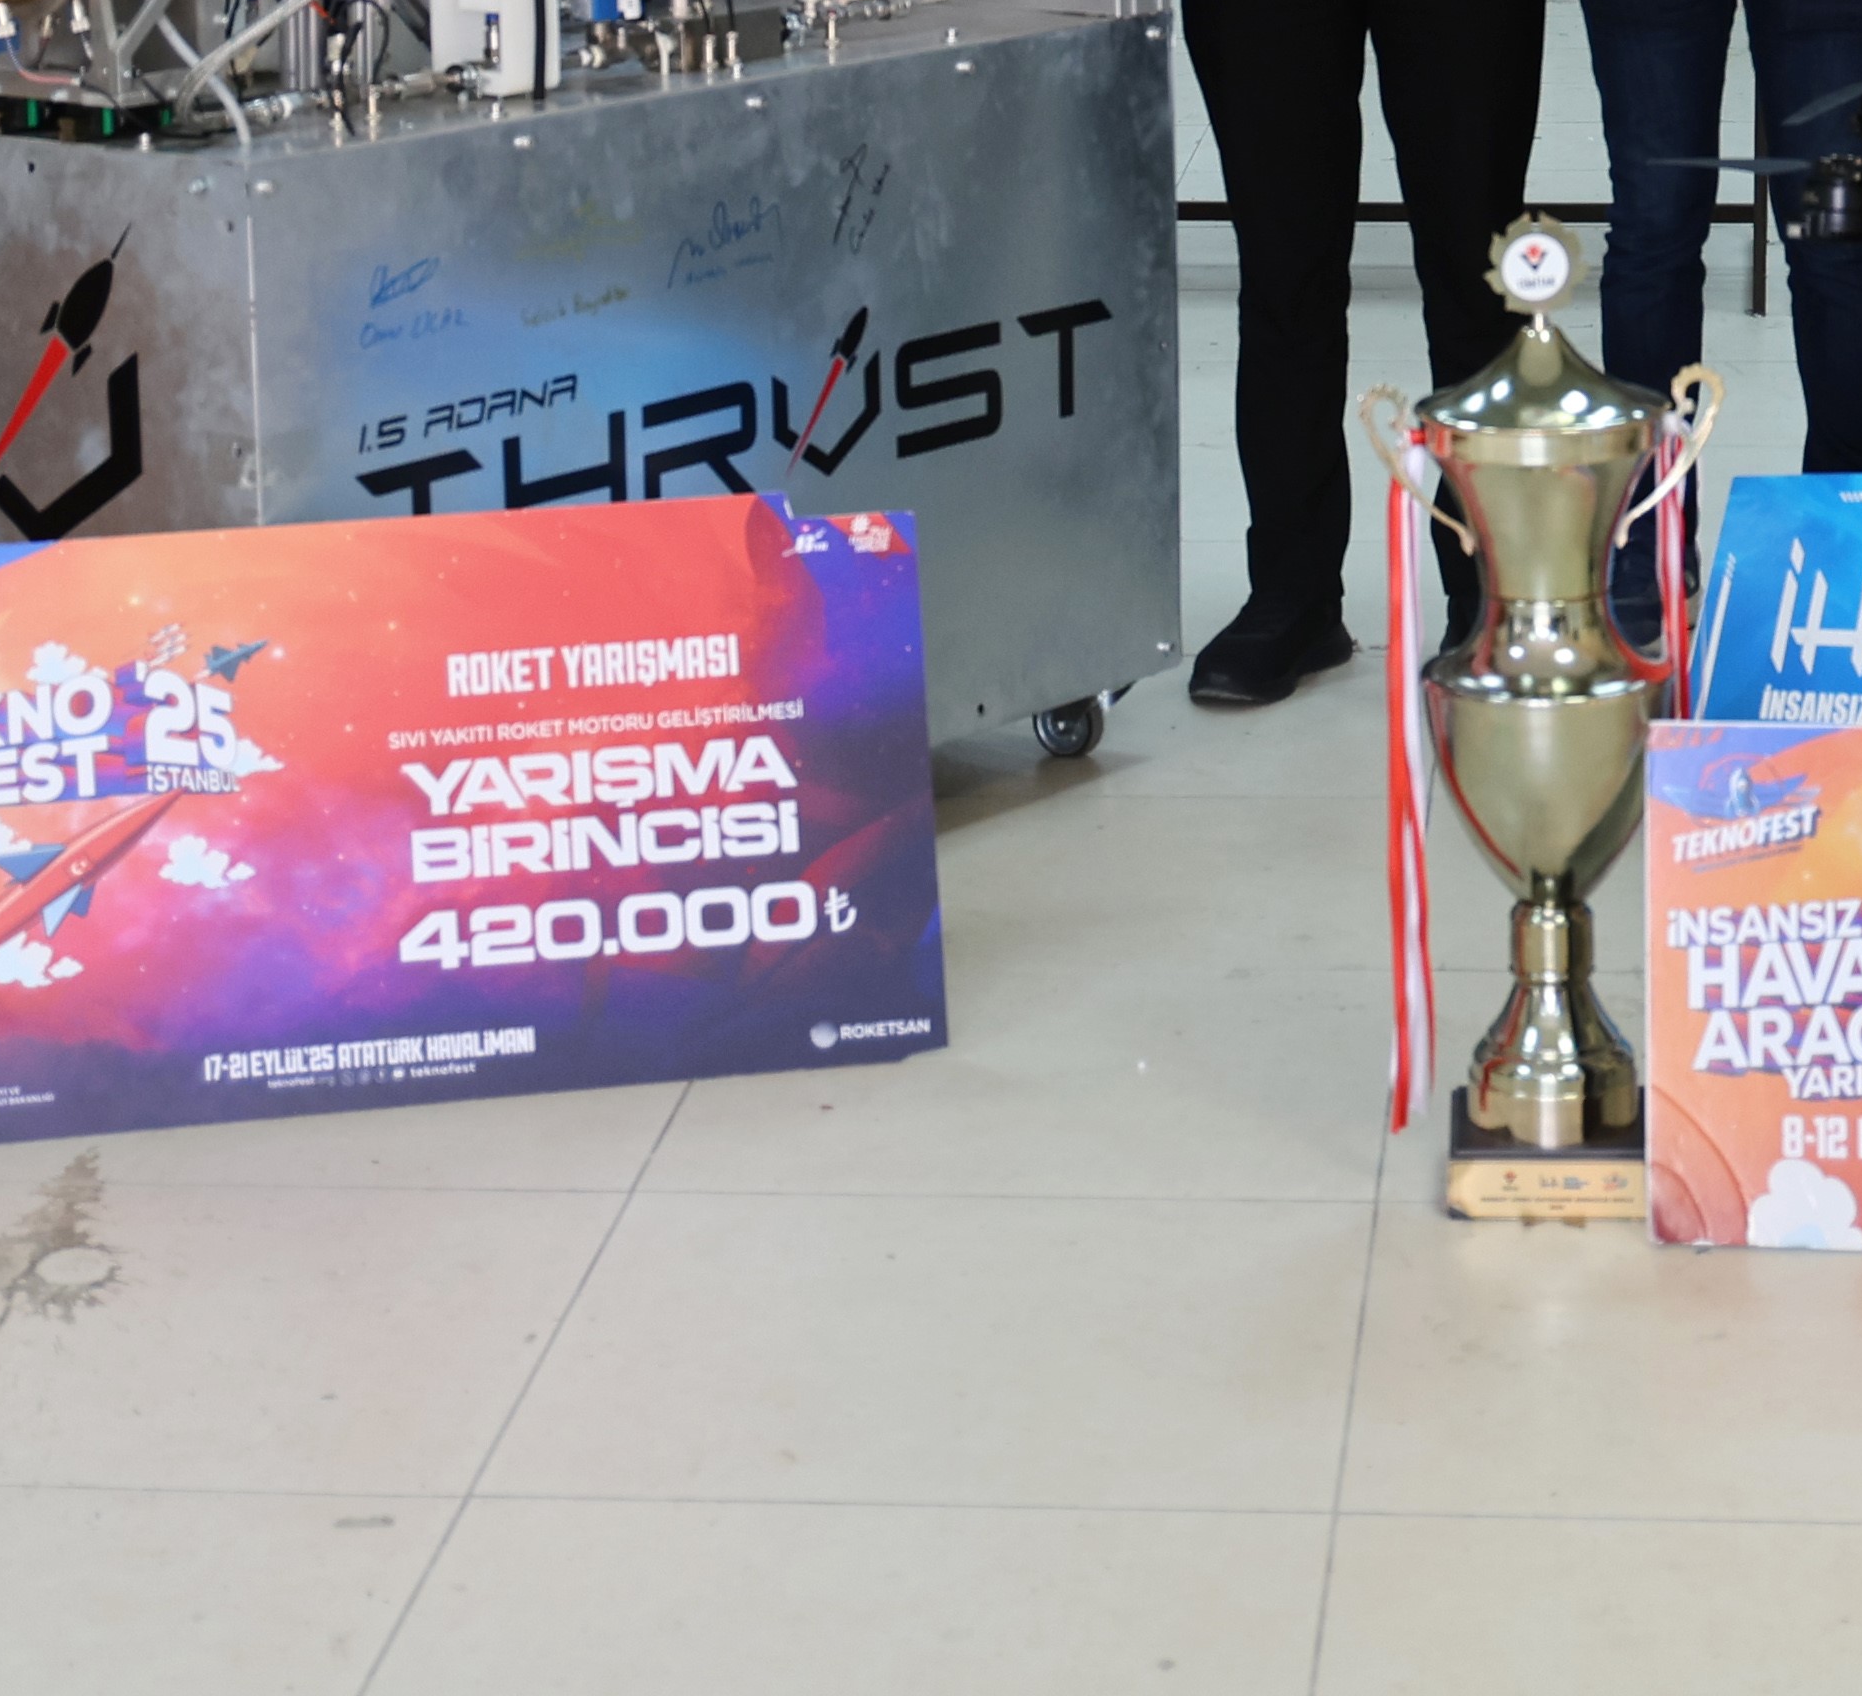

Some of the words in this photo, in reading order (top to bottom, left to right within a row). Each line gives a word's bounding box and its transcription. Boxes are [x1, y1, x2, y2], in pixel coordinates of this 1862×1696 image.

[356, 298, 1114, 516] THRUST
[424, 373, 579, 441] ADANA
[446, 647, 555, 697] ROKET
[561, 633, 740, 687] YARIŞMASI
[388, 731, 426, 750] SIVI
[497, 719, 565, 741] ROKET
[568, 712, 655, 736] MOTORU
[657, 696, 805, 732] GELİŞTİRİLMESİ
[145, 762, 241, 794] İSTANBUL
[400, 735, 799, 816] YARIŞMA
[411, 799, 801, 883] BİRİNCİSİ
[1671, 805, 1820, 863] TEKNOFEST
[203, 1051, 249, 1081] 17-21
[249, 1045, 336, 1077] EYLÜL'25
[338, 1036, 425, 1070] ATATÜRK
[425, 1026, 537, 1061] HAVALİMANI
[839, 1017, 932, 1040] ROKETSAN
[409, 1061, 477, 1079] teknofest
[1780, 1113, 1848, 1161] 8-12
